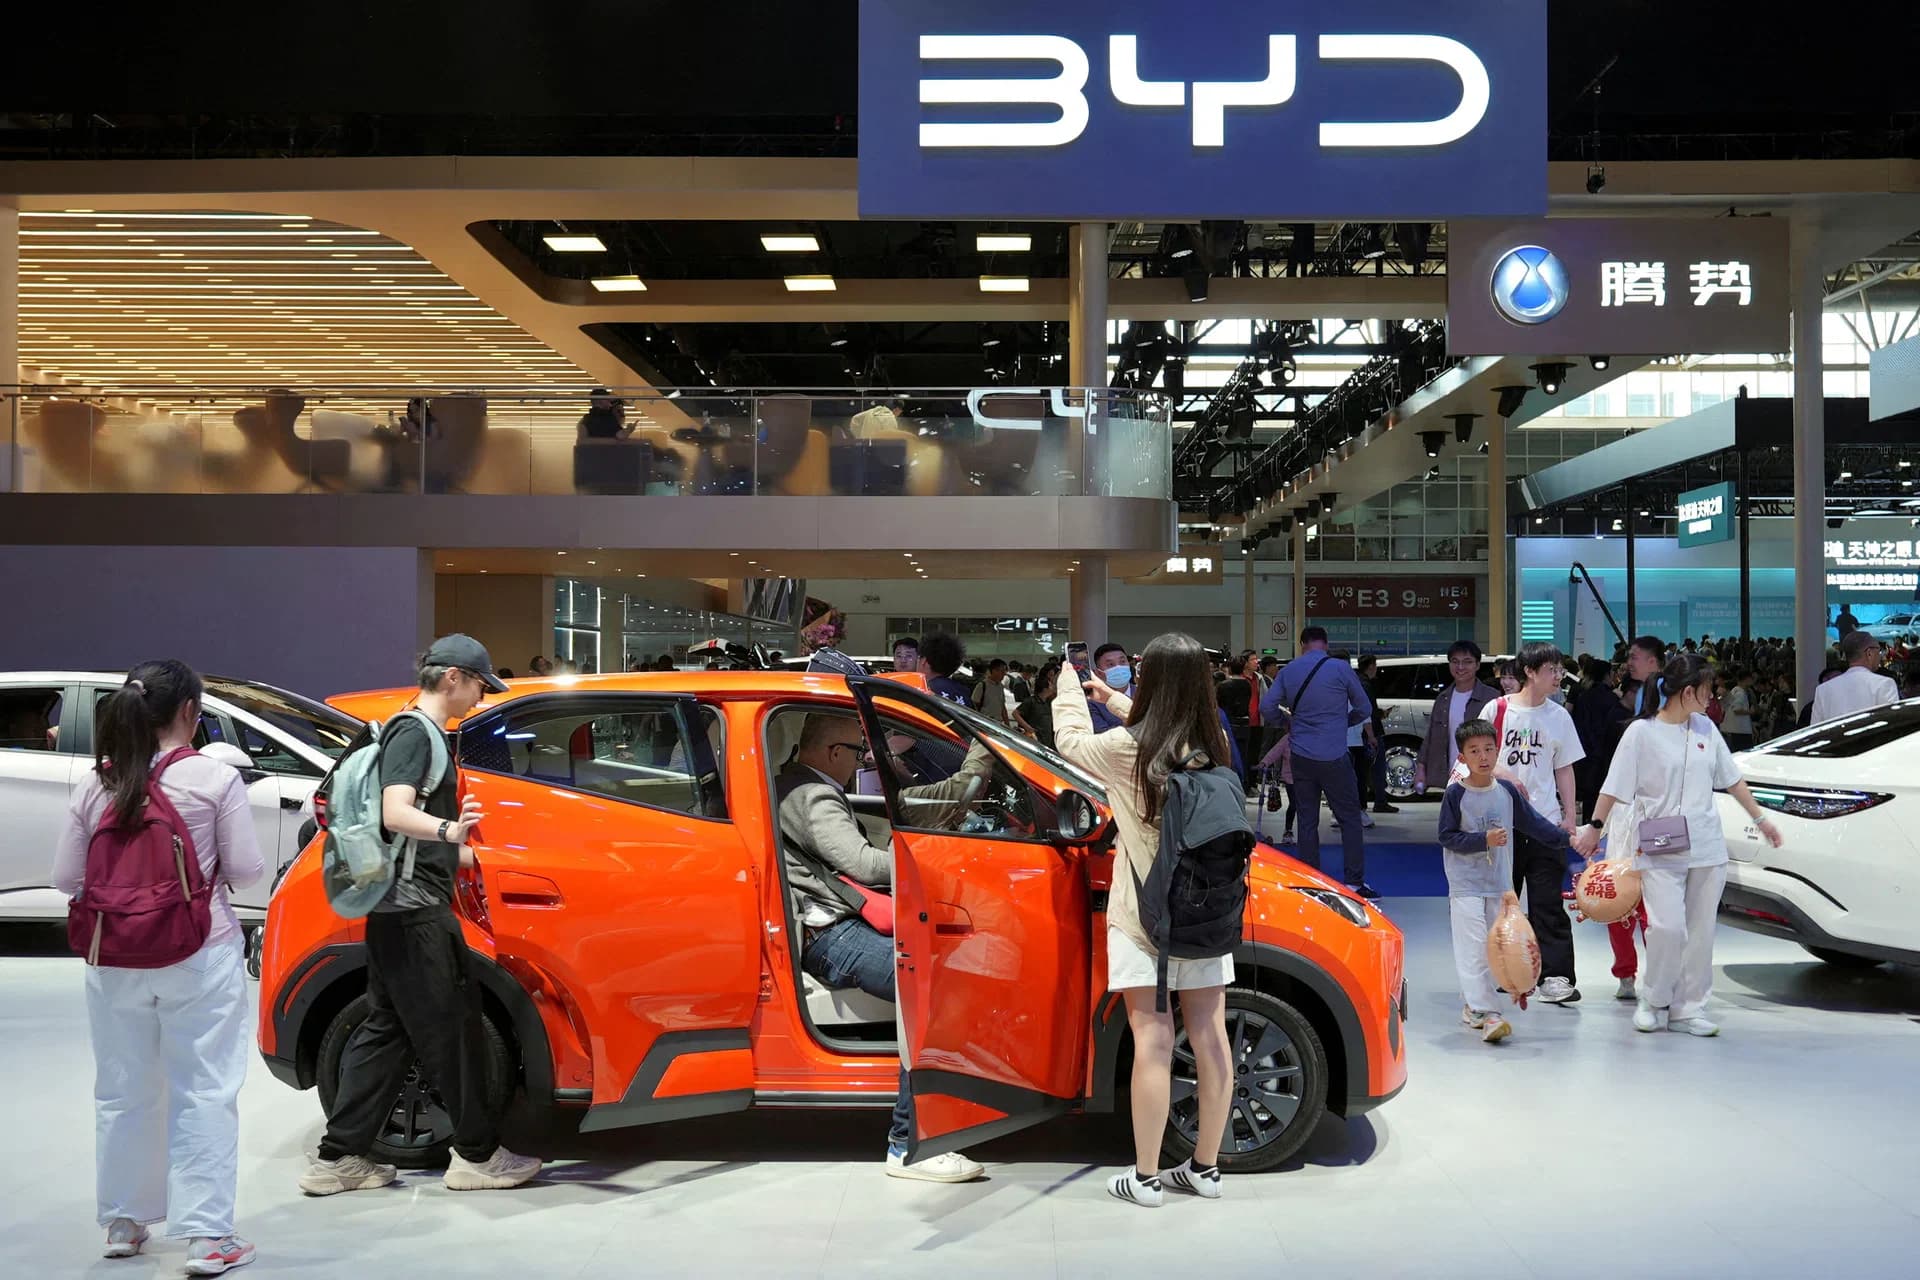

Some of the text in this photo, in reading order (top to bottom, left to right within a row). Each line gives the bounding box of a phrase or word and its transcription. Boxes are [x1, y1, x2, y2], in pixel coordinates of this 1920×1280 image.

[919, 34, 1490, 147] BYD
[1600, 261, 1752, 306] 腾势
[1333, 586, 1353, 597] W3
[1358, 590, 1390, 608] E3
[1403, 590, 1417, 608] 9
[1452, 586, 1468, 597] E4
[1505, 729, 1542, 748] CHILL
[1507, 750, 1537, 767] OUT
